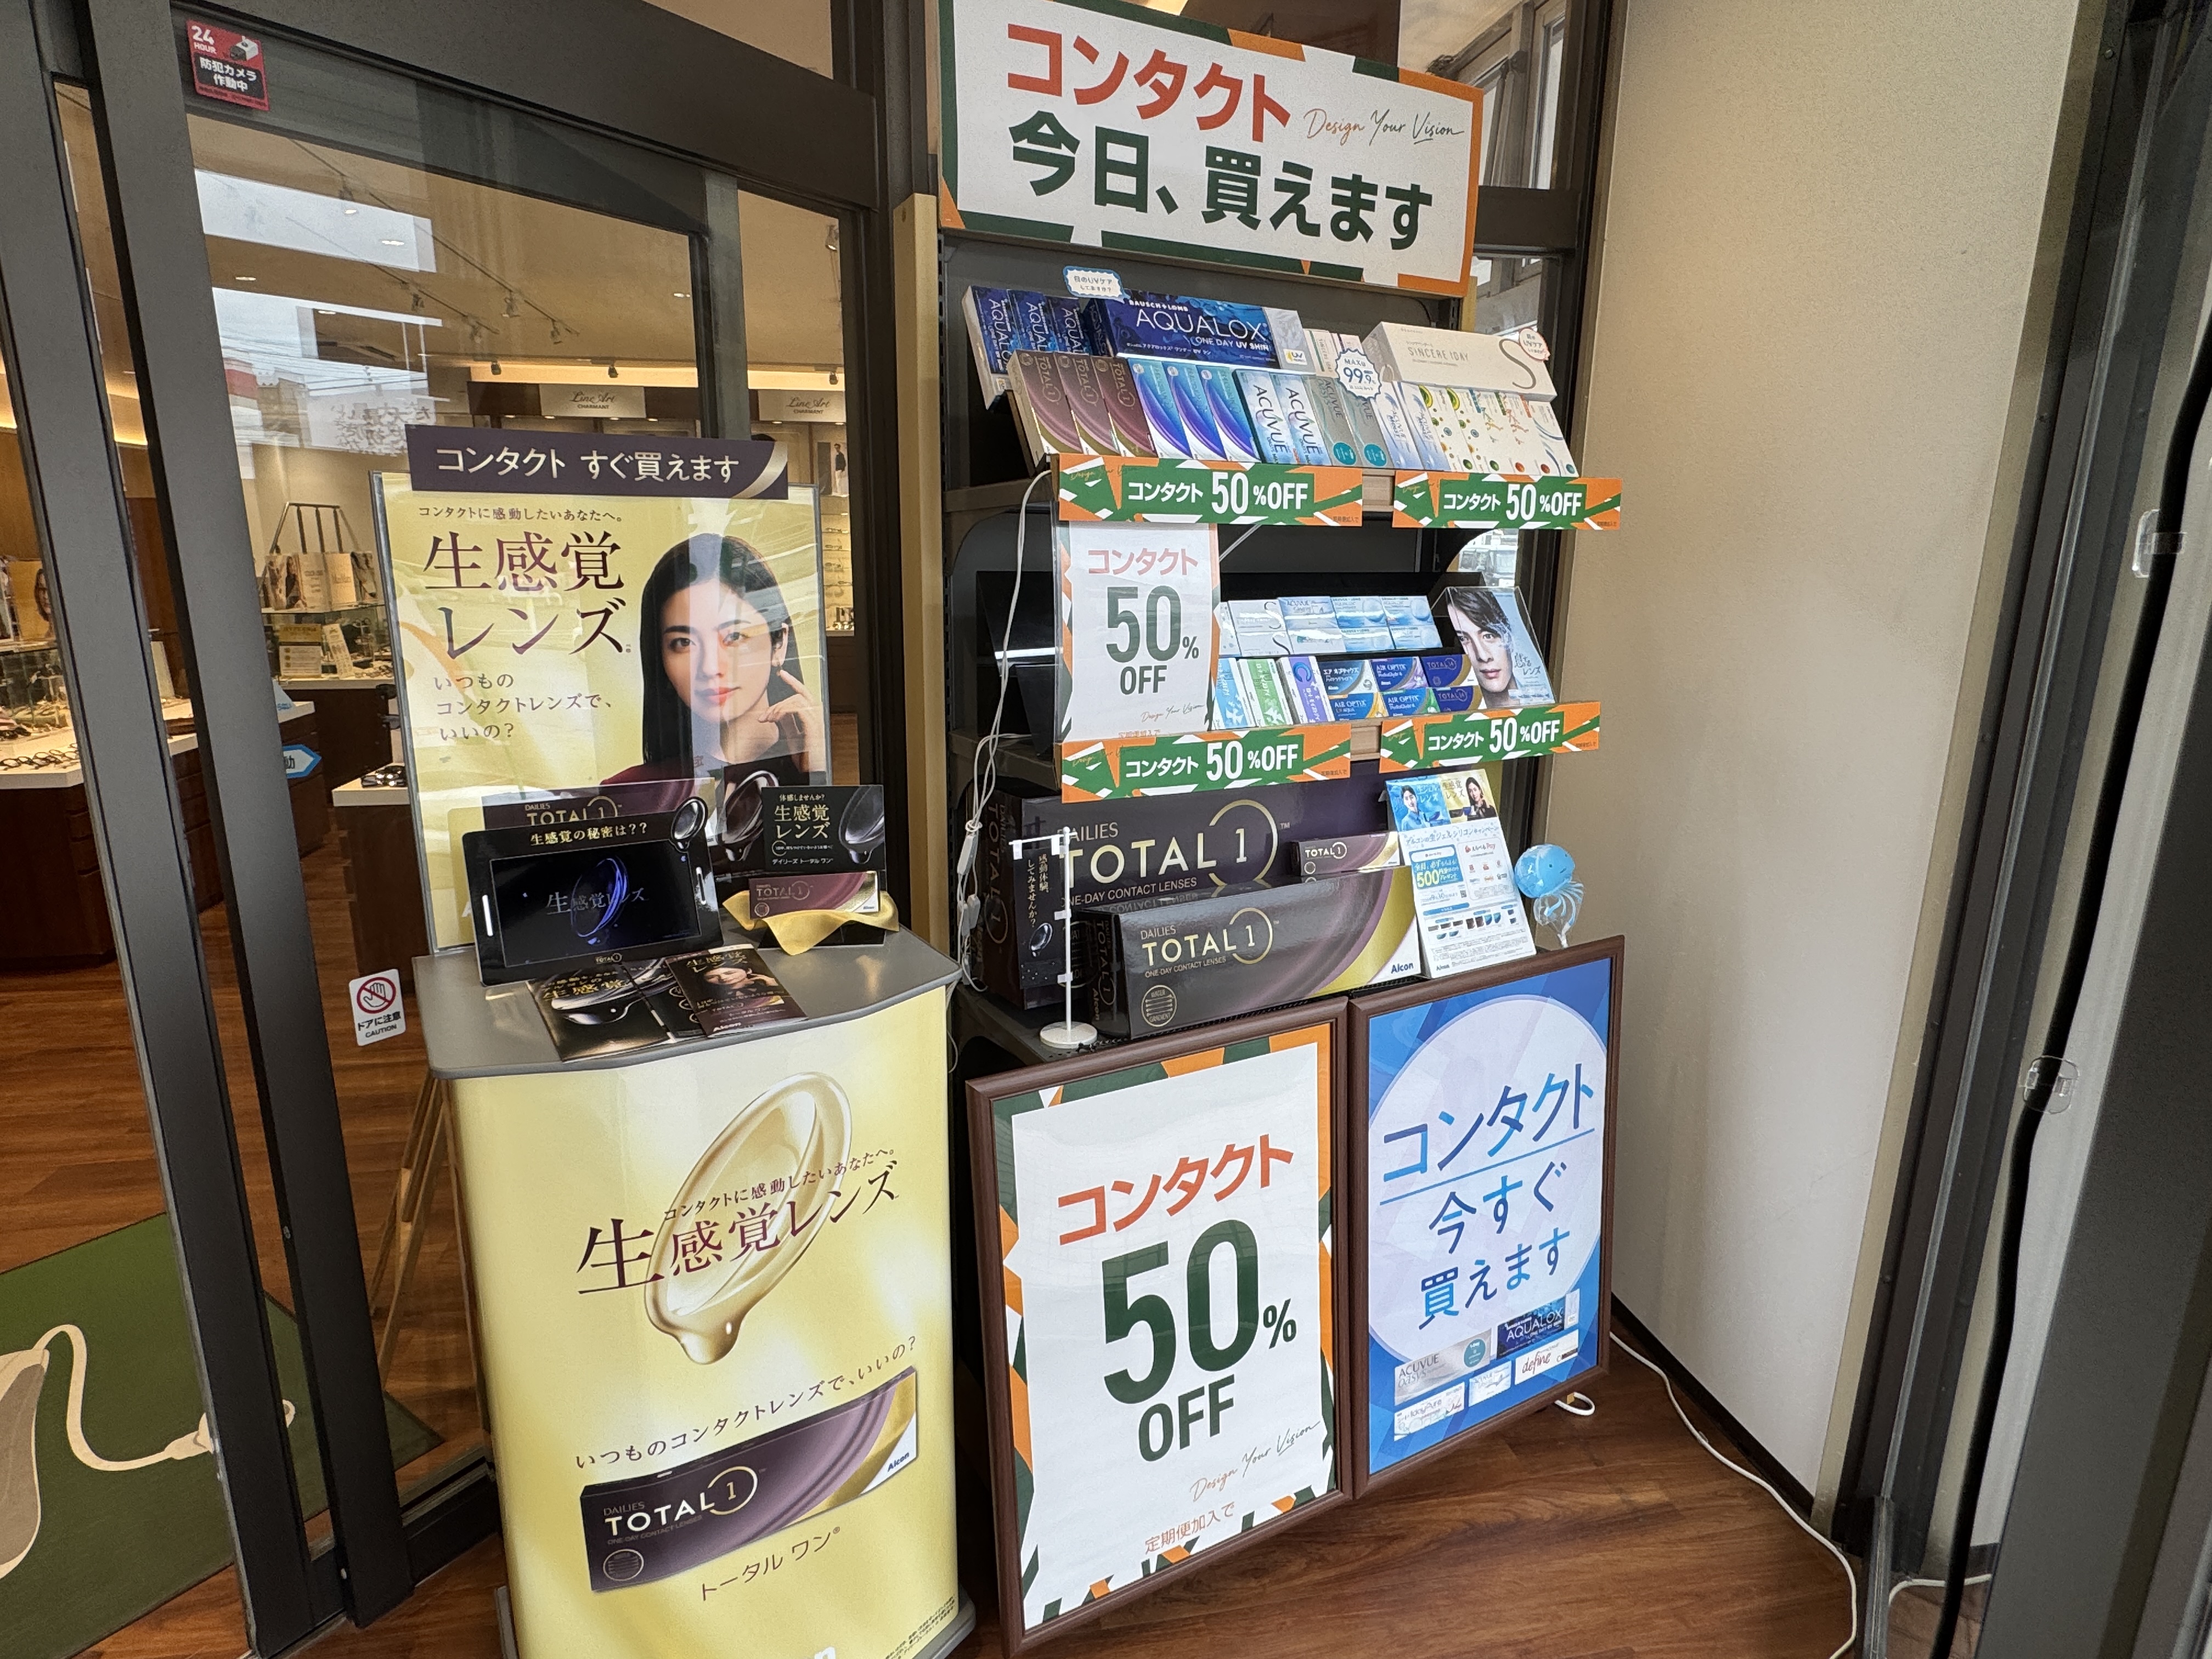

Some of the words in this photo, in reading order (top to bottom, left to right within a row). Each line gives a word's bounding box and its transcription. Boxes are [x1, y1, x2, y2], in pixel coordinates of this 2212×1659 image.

[191, 26, 215, 45] 24
[194, 42, 217, 54] HOUR
[200, 57, 257, 81] 防犯カメラ
[1007, 23, 1291, 142] コンタクト
[213, 74, 249, 92] 作動中
[1303, 108, 1365, 139] Design
[1369, 108, 1406, 146] Your
[1411, 111, 1464, 144] Vision
[1008, 110, 1433, 250] 今日、買えます
[988, 298, 1012, 371] AQUALO
[1025, 301, 1048, 351] AQUAL
[1062, 307, 1084, 353] AQUAL
[1136, 309, 1267, 341] AQUALOX
[1216, 338, 1234, 348] DAY
[1407, 347, 1447, 361] SINCERE
[1037, 357, 1053, 389] TOTAL
[1075, 358, 1091, 390] TOTAL
[1112, 362, 1128, 394] TOTAL
[1253, 385, 1289, 454] ACUVUE
[1285, 387, 1321, 455] ACUVUE
[436, 447, 566, 478] コンタクト
[580, 451, 740, 484] すぐ買えます
[1128, 482, 1204, 503] コンタクト
[1443, 493, 1501, 511] コンタクト
[419, 506, 623, 523] コンタクトに感動したいあなたへ。
[423, 531, 625, 592] 生感覚
[1088, 548, 1198, 575] コンタクト
[438, 598, 627, 660] レンズ
[433, 673, 514, 691] いつもの
[1120, 665, 1167, 696] OFF
[436, 693, 612, 716] コンタクトレンズで、
[439, 723, 515, 741] いいの？
[1428, 731, 1485, 751] コンタクト
[1126, 756, 1199, 778] コンタクト
[524, 803, 551, 811] DAILIES
[774, 804, 830, 822] 生感覚
[531, 822, 647, 847] 生感覚の秘密は？？
[776, 822, 831, 839] レンズ
[1059, 833, 1217, 888] TOTAL
[1305, 848, 1335, 858] TOTAL
[755, 887, 793, 898] TOTAL
[1107, 883, 1156, 904] CONTACT
[1158, 877, 1198, 893] LENSES
[1417, 870, 1440, 888] 500
[1140, 924, 1176, 939] DAILIES
[1142, 928, 1237, 966] TOTAL
[1173, 962, 1202, 974] CONTACT
[1203, 956, 1226, 968] LENSES
[1390, 961, 1414, 975] Alcon
[358, 1011, 401, 1031] ドアに注意
[365, 1024, 397, 1038] CAUTION
[1384, 1063, 1593, 1183] コンタクト
[664, 1148, 895, 1221] コンタクトに感動したいあなたへ。
[1058, 1134, 1294, 1245] コンタクト
[1429, 1161, 1567, 1254] 今すぐ
[576, 1159, 898, 1295] 生感覚レンズ
[1419, 1227, 1570, 1330] 買えます
[1506, 1307, 1564, 1342] AQUALOX
[1399, 1353, 1440, 1379] ACUVUE
[575, 1335, 916, 1470] いつものコンタクトレンズで、いいの？
[1138, 1374, 1235, 1462] OFF
[887, 1452, 910, 1472] Alcon
[1189, 1468, 1238, 1503] Design
[1242, 1447, 1271, 1478] Your
[1277, 1421, 1321, 1457] Vision
[603, 1501, 645, 1516] DAILIES
[605, 1492, 715, 1536] TOTAL
[640, 1525, 674, 1539] CONTACT
[1145, 1502, 1235, 1555] 定期便加入で
[701, 1556, 783, 1601] トータル
